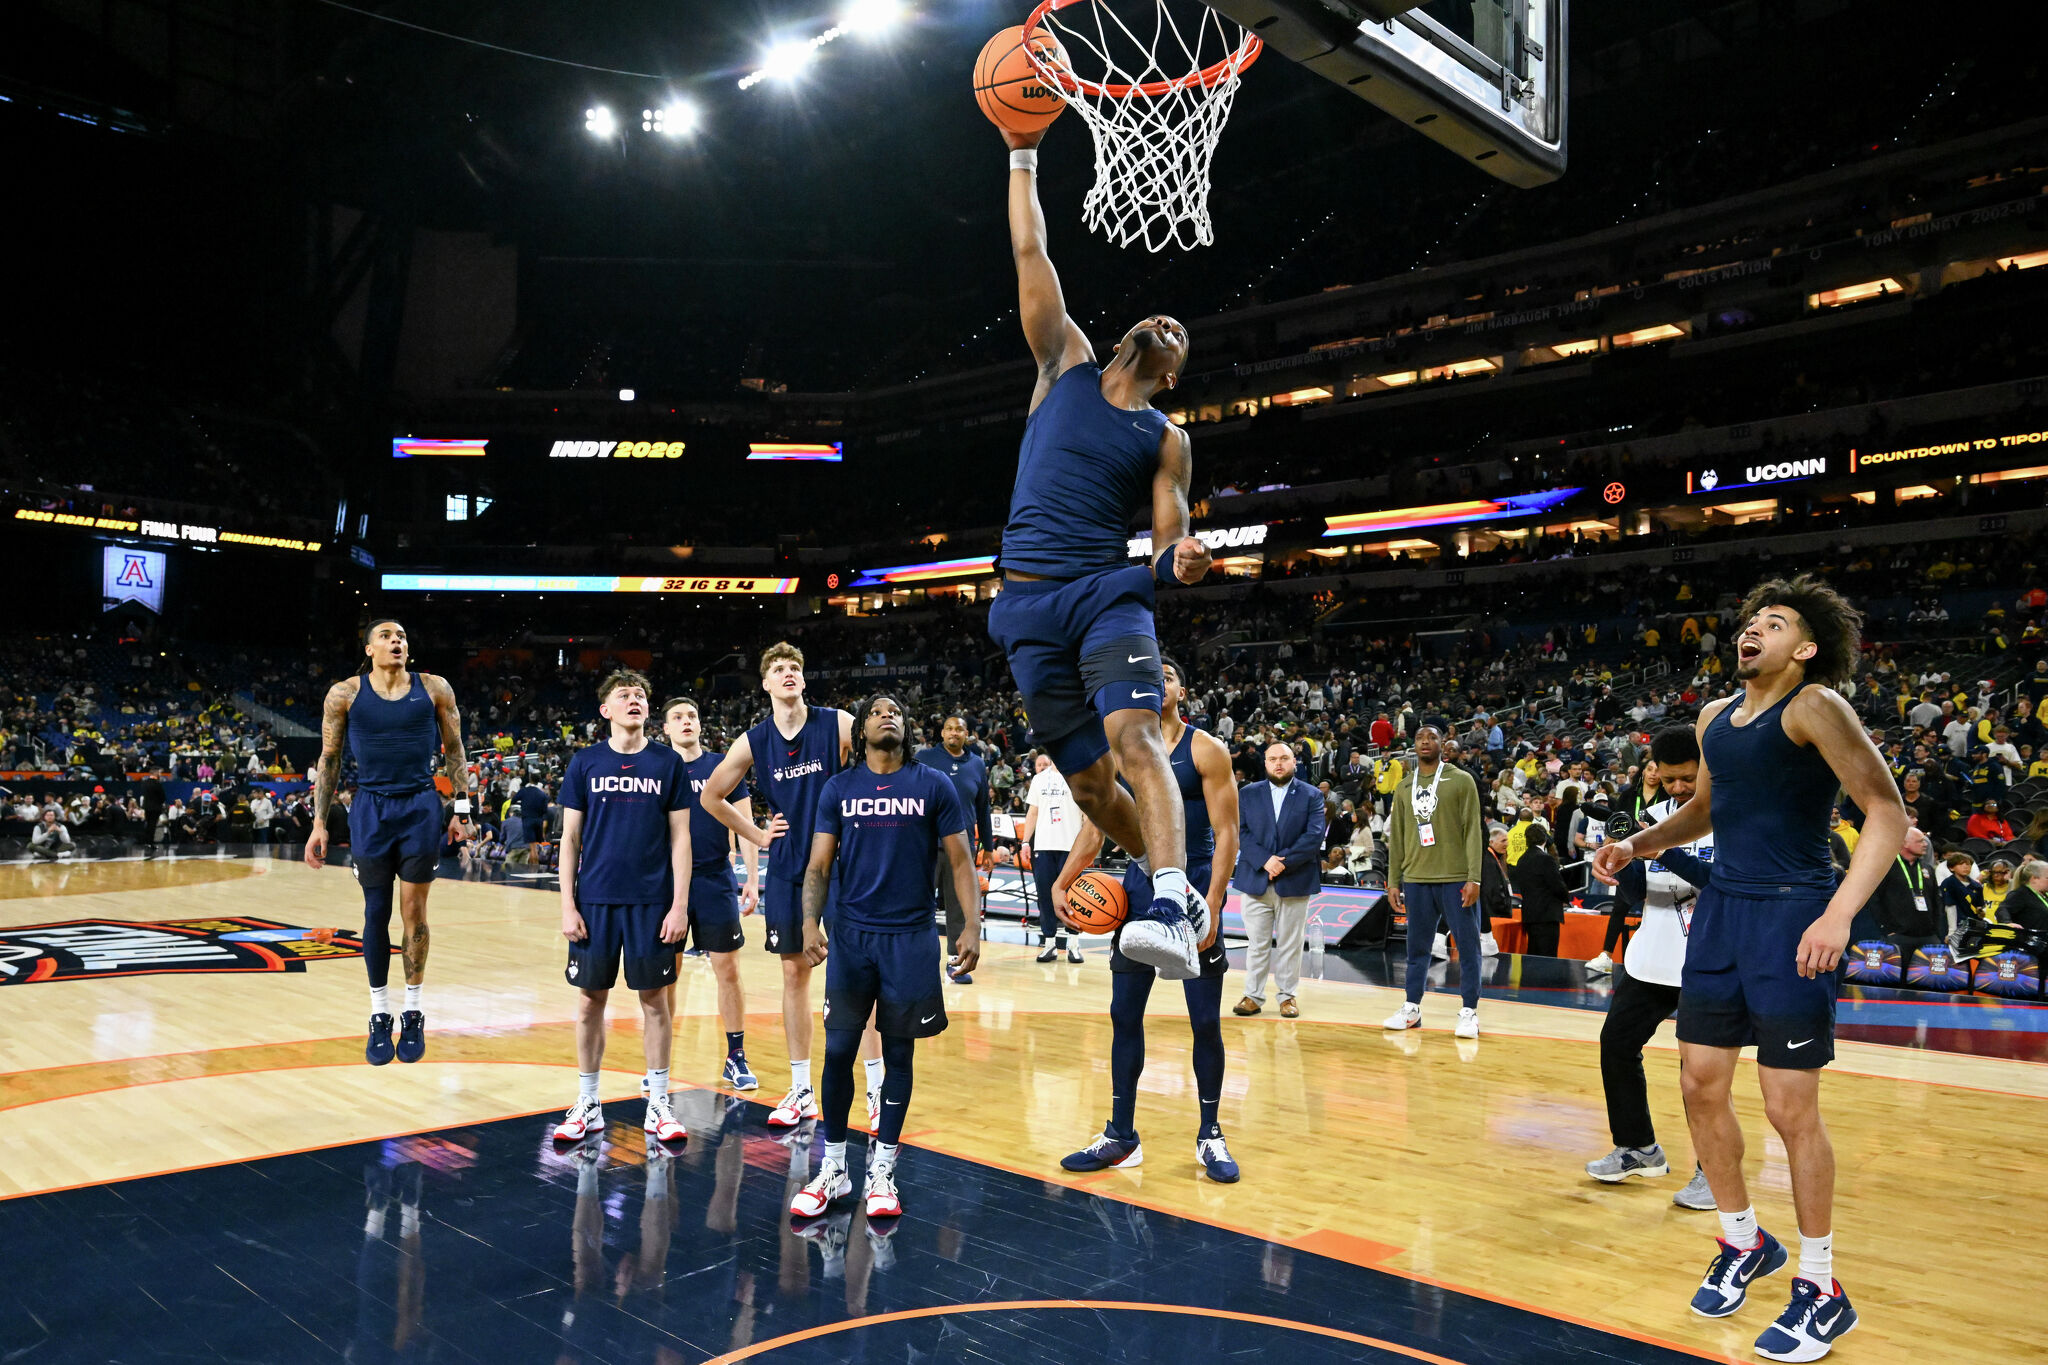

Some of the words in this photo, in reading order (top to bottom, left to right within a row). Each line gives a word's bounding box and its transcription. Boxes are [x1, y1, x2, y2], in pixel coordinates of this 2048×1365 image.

[1722, 260, 1773, 280] NATION
[549, 440, 618, 458] INDY
[613, 441, 686, 459] 2026
[1860, 442, 1970, 465] COUNTDOWN
[1973, 438, 1997, 450] TO
[1746, 457, 1826, 483] UCONN
[15, 509, 55, 522] 2026
[54, 513, 95, 527] NCAA
[95, 518, 139, 532] MEN'S
[141, 520, 179, 538] FINAL
[181, 524, 217, 543] FOUR
[117, 555, 153, 588] A
[663, 580, 685, 590] 32
[690, 580, 709, 590] 16
[715, 580, 730, 590] 8
[736, 580, 755, 590] 4
[785, 761, 823, 779] UCONN
[591, 776, 661, 795] UCONN
[841, 798, 925, 817] UCONN
[1075, 879, 1107, 906] Wilson
[1069, 897, 1093, 918] NCAA
